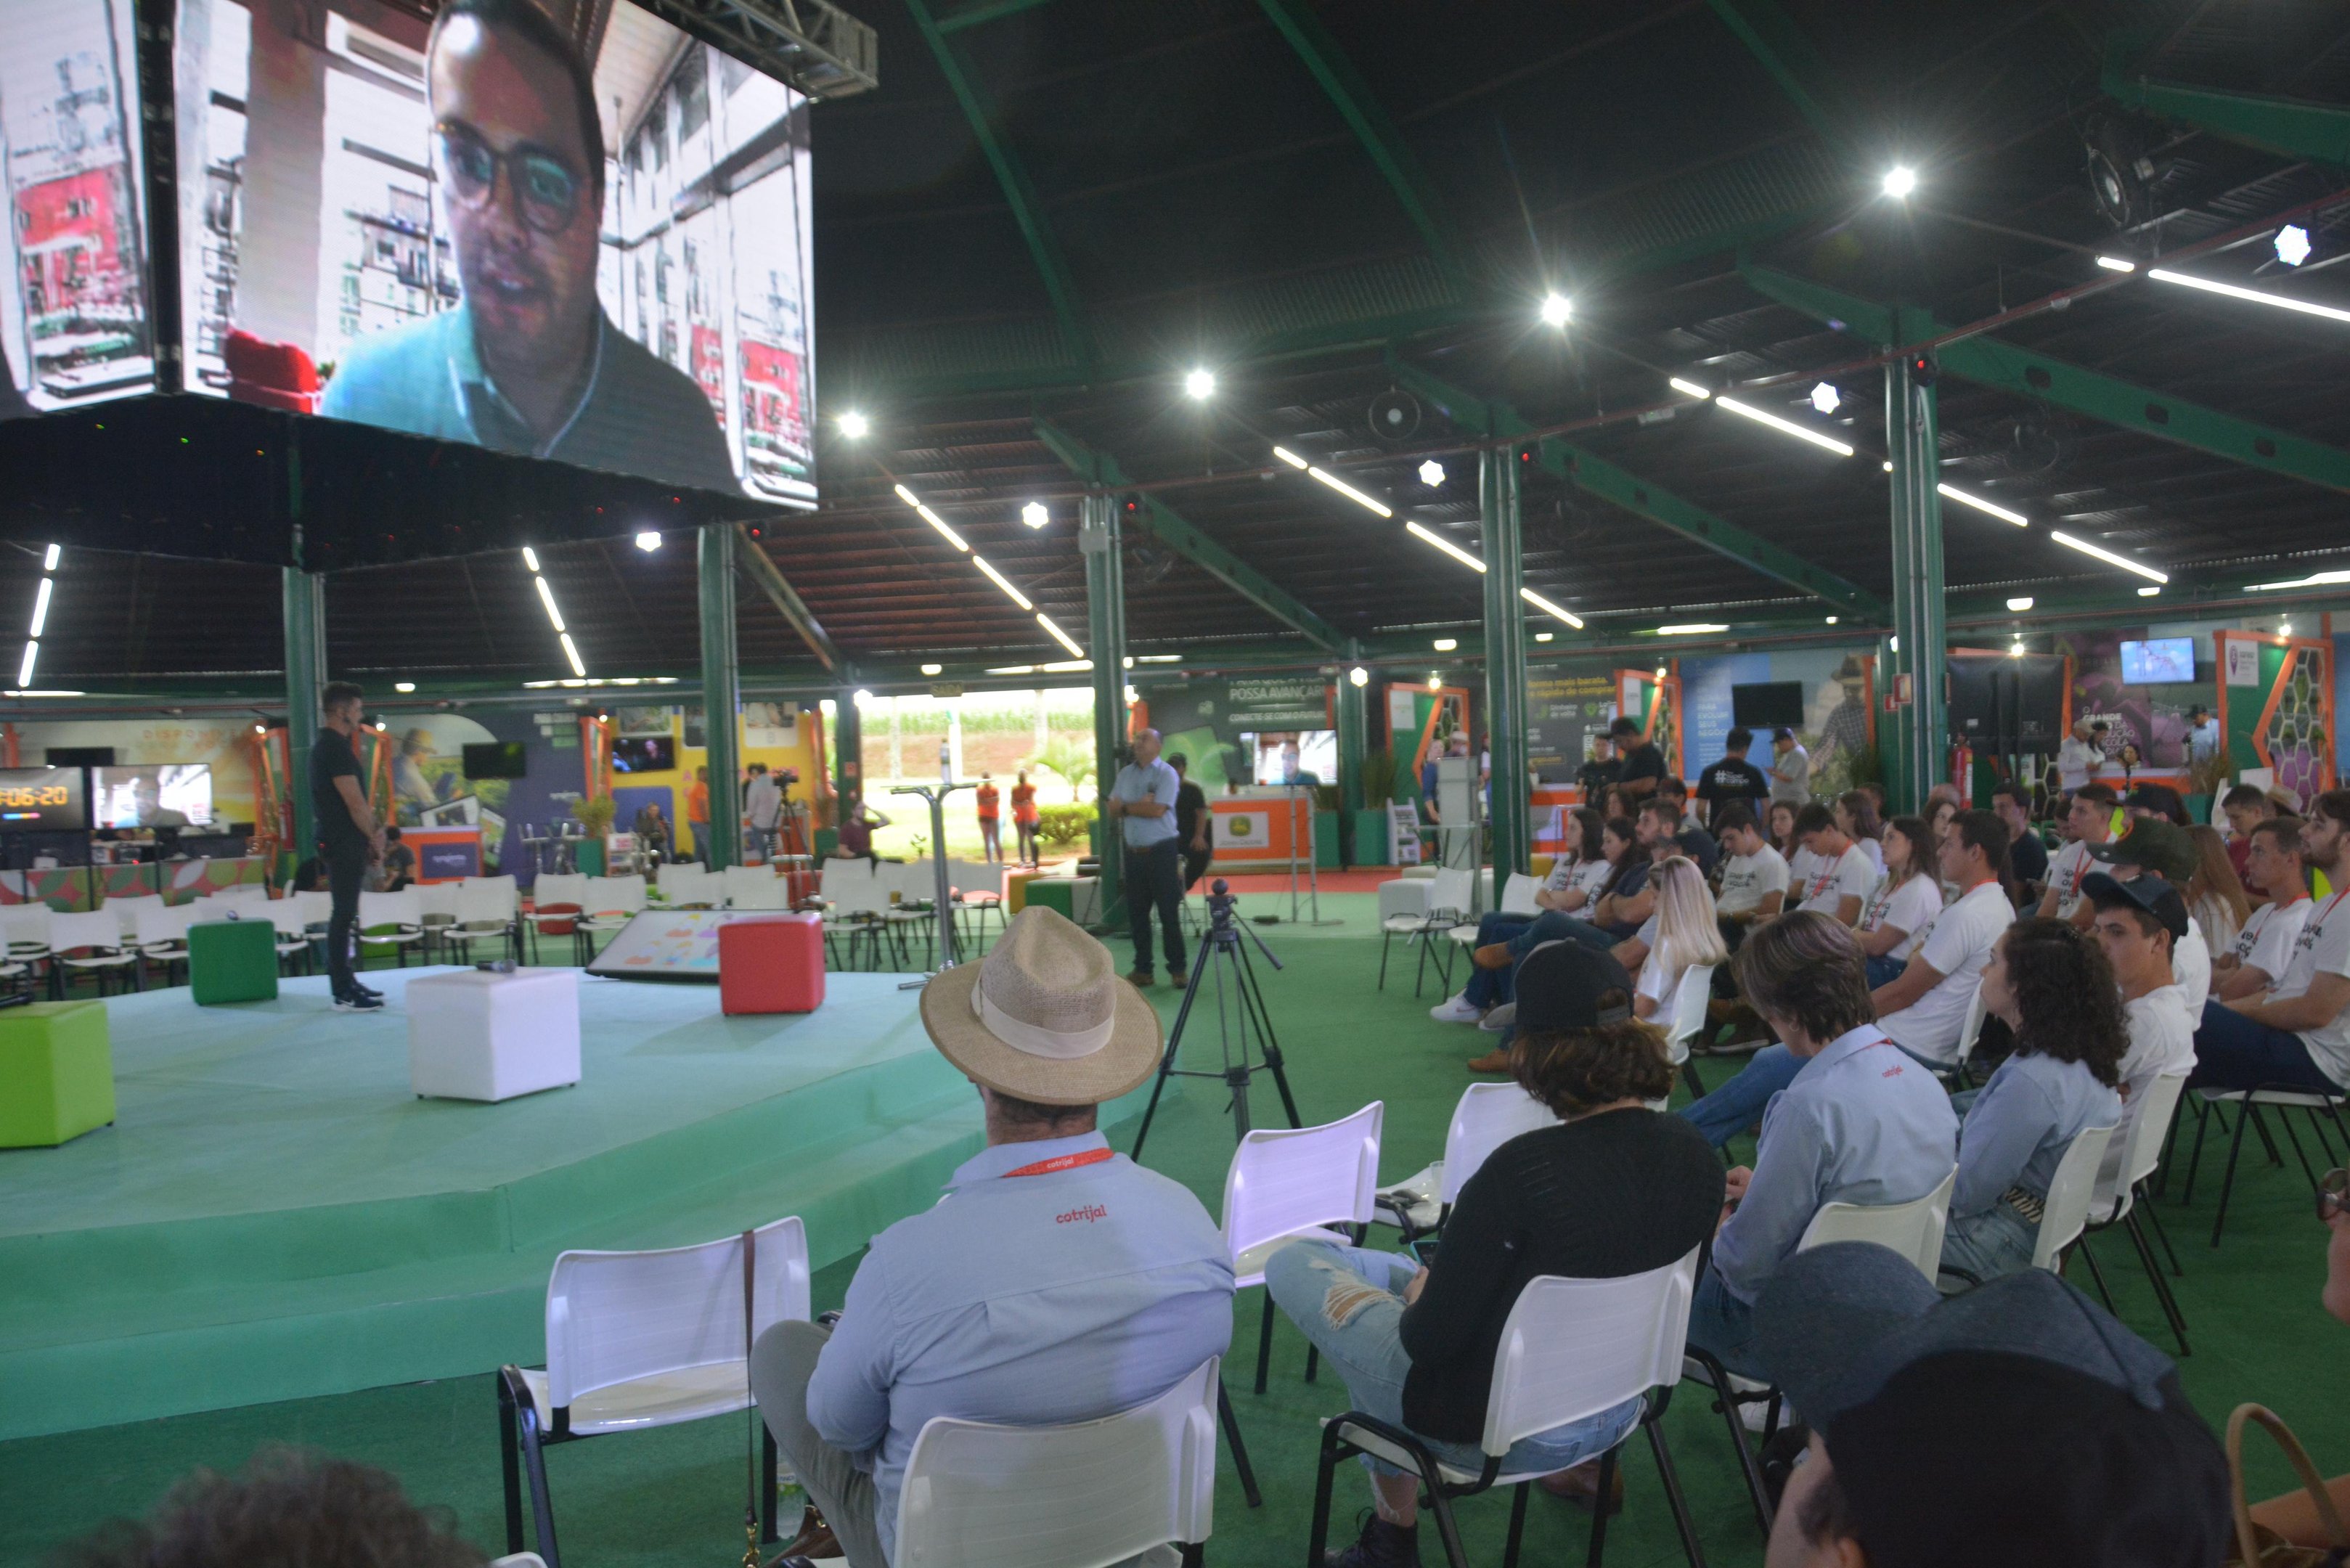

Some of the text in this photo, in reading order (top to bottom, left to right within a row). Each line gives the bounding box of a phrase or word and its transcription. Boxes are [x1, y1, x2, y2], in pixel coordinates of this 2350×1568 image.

[1230, 687, 1268, 700] POSSA
[2083, 706, 2091, 714] O
[1228, 713, 1274, 722] CONECTE-SE
[1275, 711, 1292, 720] COM
[2083, 714, 2122, 722] GRANDE
[1047, 1156, 1074, 1169] cotrijal
[1056, 1204, 1106, 1223] cotrijal
